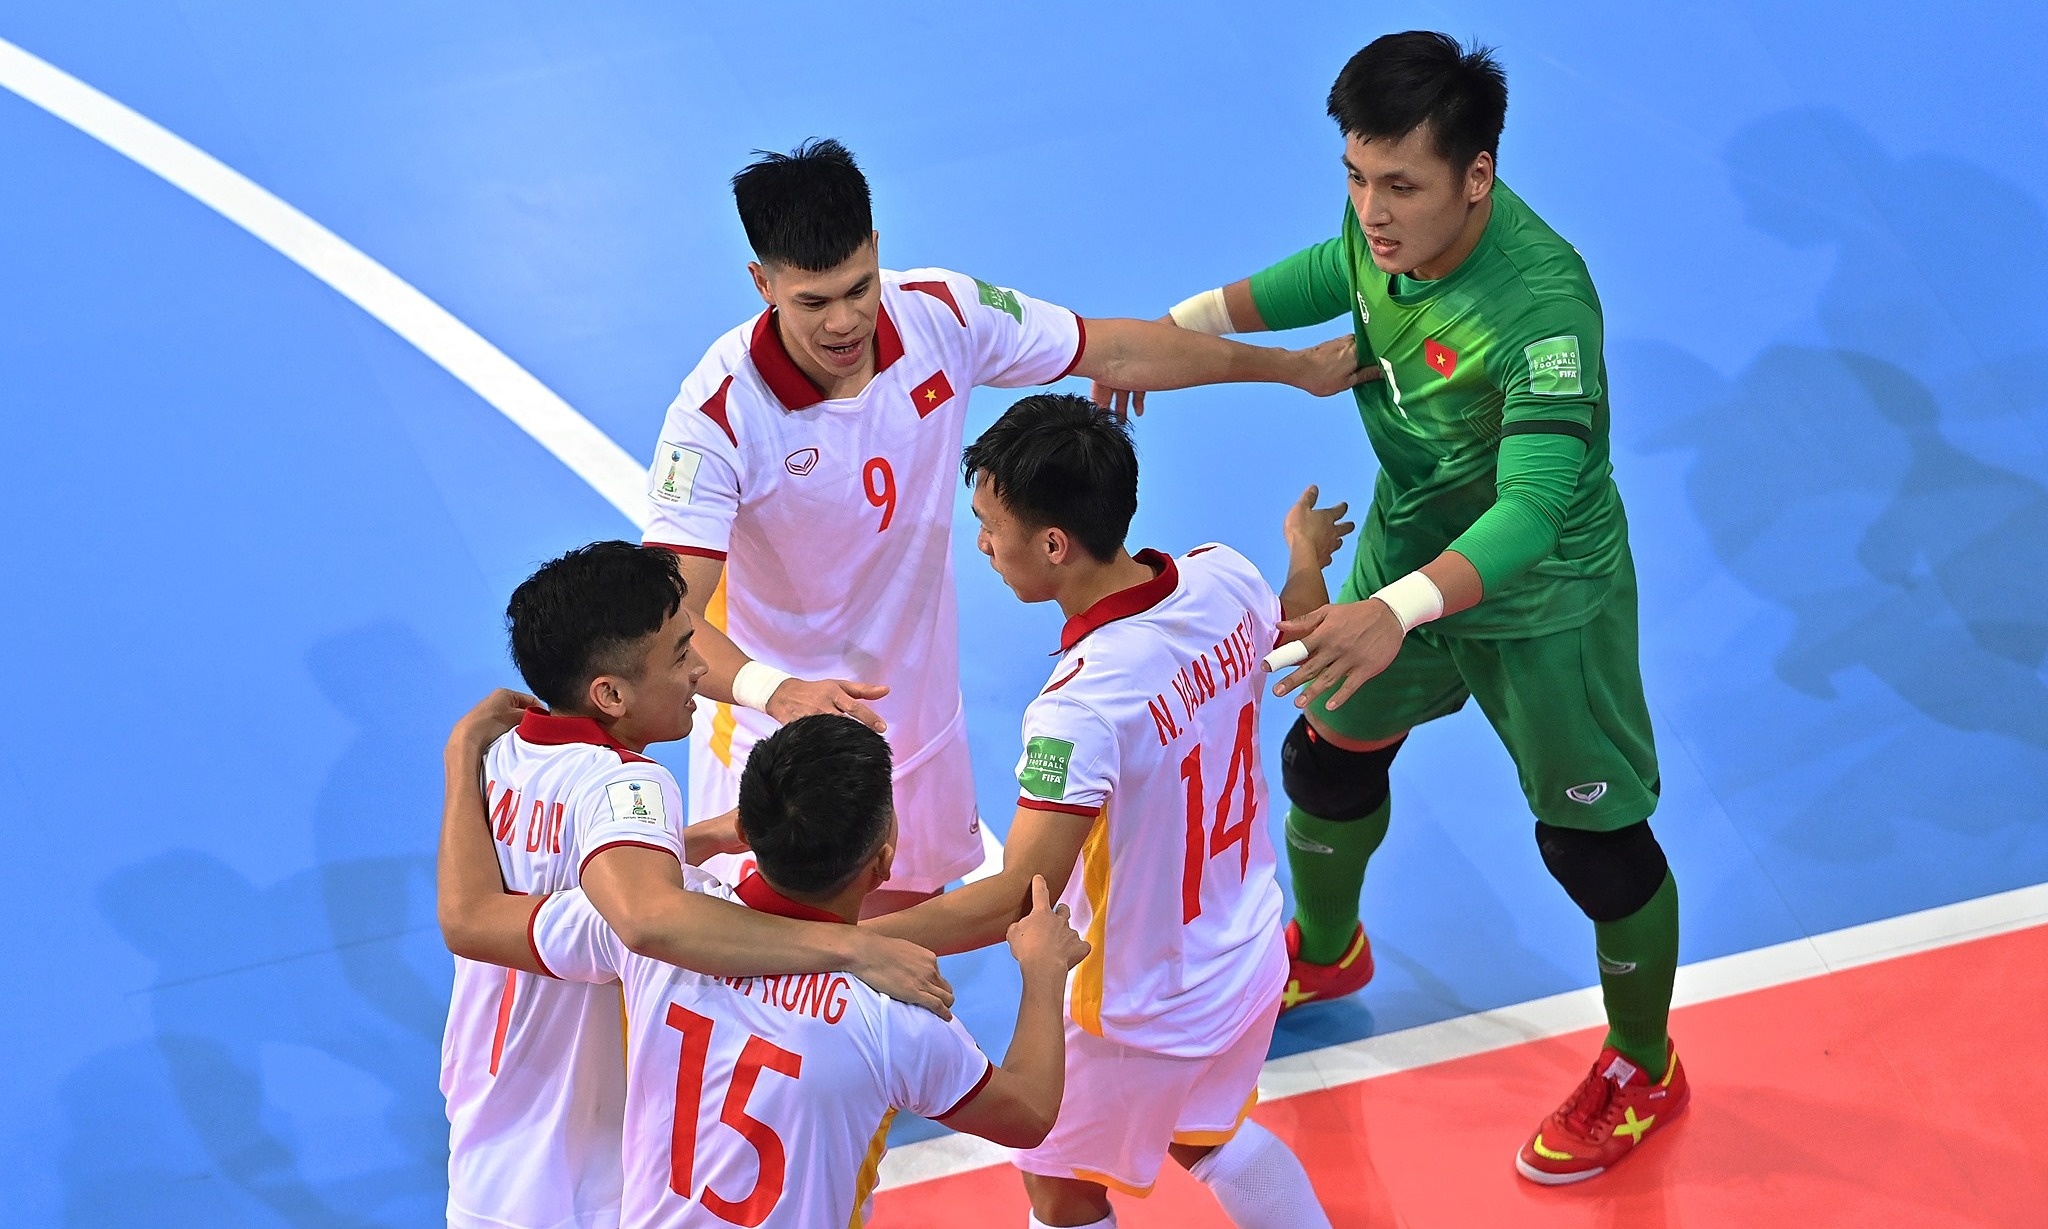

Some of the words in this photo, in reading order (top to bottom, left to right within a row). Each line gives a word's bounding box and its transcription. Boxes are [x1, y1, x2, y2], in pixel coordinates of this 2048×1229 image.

[1533, 352, 1576, 364] LIVING
[1533, 358, 1576, 370] FOOTBALL
[1559, 370, 1577, 378] FIFA
[863, 456, 897, 533] 9
[1147, 693, 1183, 746] N.
[1171, 653, 1215, 722] VAN
[1030, 752, 1065, 763] LIVING
[1041, 773, 1062, 784] FIFA
[1180, 700, 1257, 925] 14
[666, 1002, 803, 1229] 15
